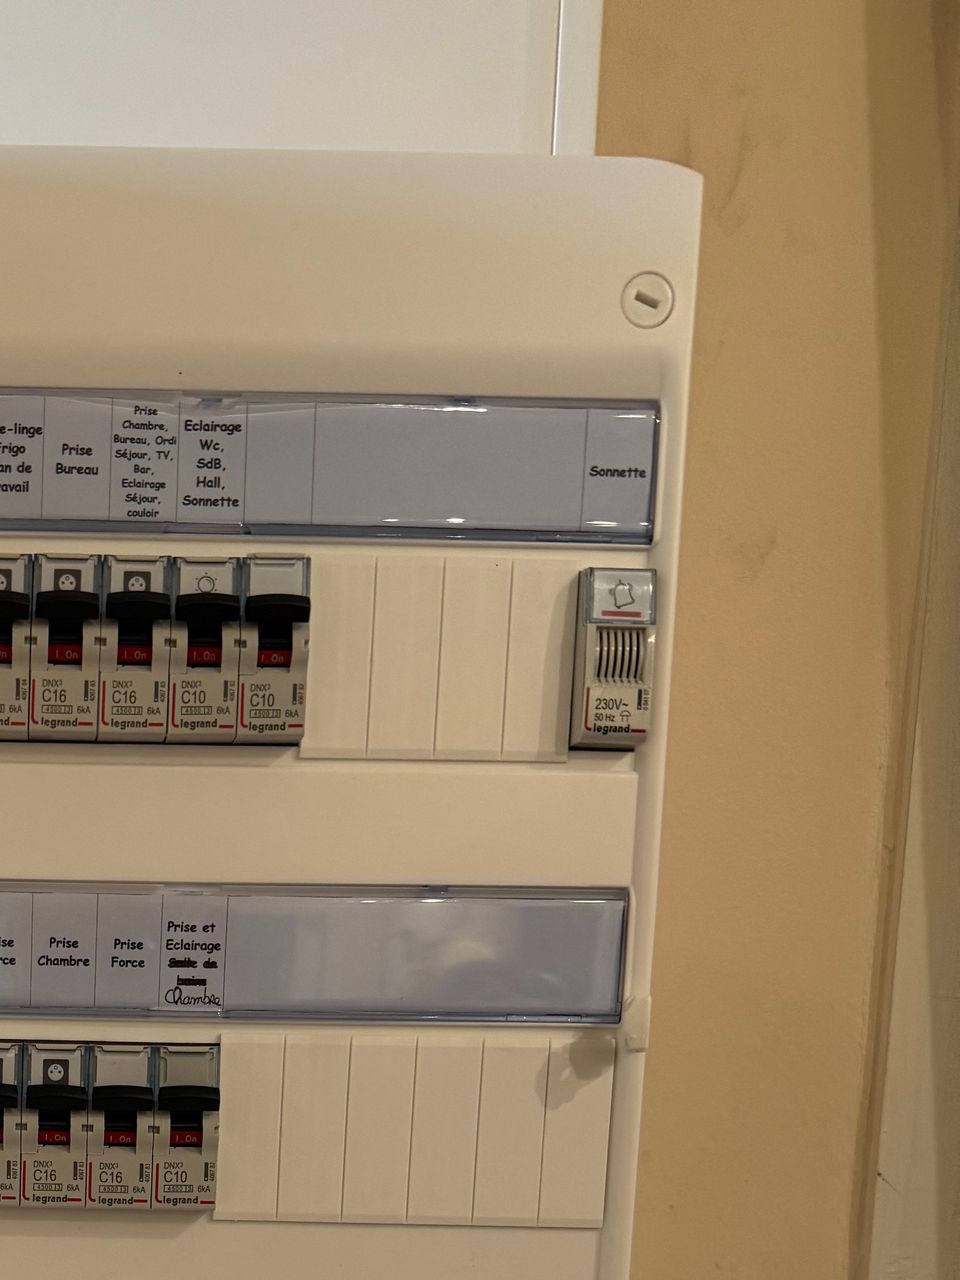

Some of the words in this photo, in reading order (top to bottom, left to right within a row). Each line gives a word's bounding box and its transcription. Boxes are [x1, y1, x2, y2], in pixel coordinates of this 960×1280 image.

[134, 405, 158, 416] Prise
[122, 419, 168, 432] Chambre,
[184, 419, 242, 436] Eclairage
[113, 434, 151, 446] Bureau,
[155, 435, 177, 445] Ordi
[199, 439, 225, 453] Wc,
[61, 443, 93, 456] Prise
[114, 449, 152, 461] Séjour,
[17, 462, 32, 474] de
[56, 462, 99, 476] Bureau
[133, 464, 154, 476] Bar,
[196, 458, 226, 471] SdB,
[589, 465, 647, 479] Sonnette
[121, 478, 166, 491] Eclairage
[196, 476, 225, 490] Hall,
[125, 493, 161, 505] Séjour,
[182, 495, 240, 508] Sonnette
[127, 508, 159, 518] couloir
[41, 689, 67, 703] C16
[112, 690, 137, 704] C16
[181, 690, 206, 704] C10
[250, 694, 275, 707] C10
[41, 717, 78, 728] legrand
[111, 718, 148, 729] legrand
[180, 718, 218, 730] legrand
[594, 713, 603, 722] 50
[605, 713, 616, 723] Hz
[248, 722, 286, 733] legrand
[593, 722, 630, 734] legrand
[167, 921, 197, 933] Prise
[202, 922, 216, 933] et
[49, 936, 79, 949] Prise
[113, 938, 144, 951] Prise
[165, 939, 221, 954] Eclairage
[37, 955, 90, 968] Chambre
[110, 956, 145, 968] Force
[164, 986, 221, 1006] Chambre
[33, 1169, 57, 1181] C16
[99, 1171, 123, 1183] C16
[164, 1170, 188, 1183] C10
[32, 1194, 68, 1204] legrand
[98, 1195, 134, 1205] legrand
[163, 1195, 198, 1205] legrand
